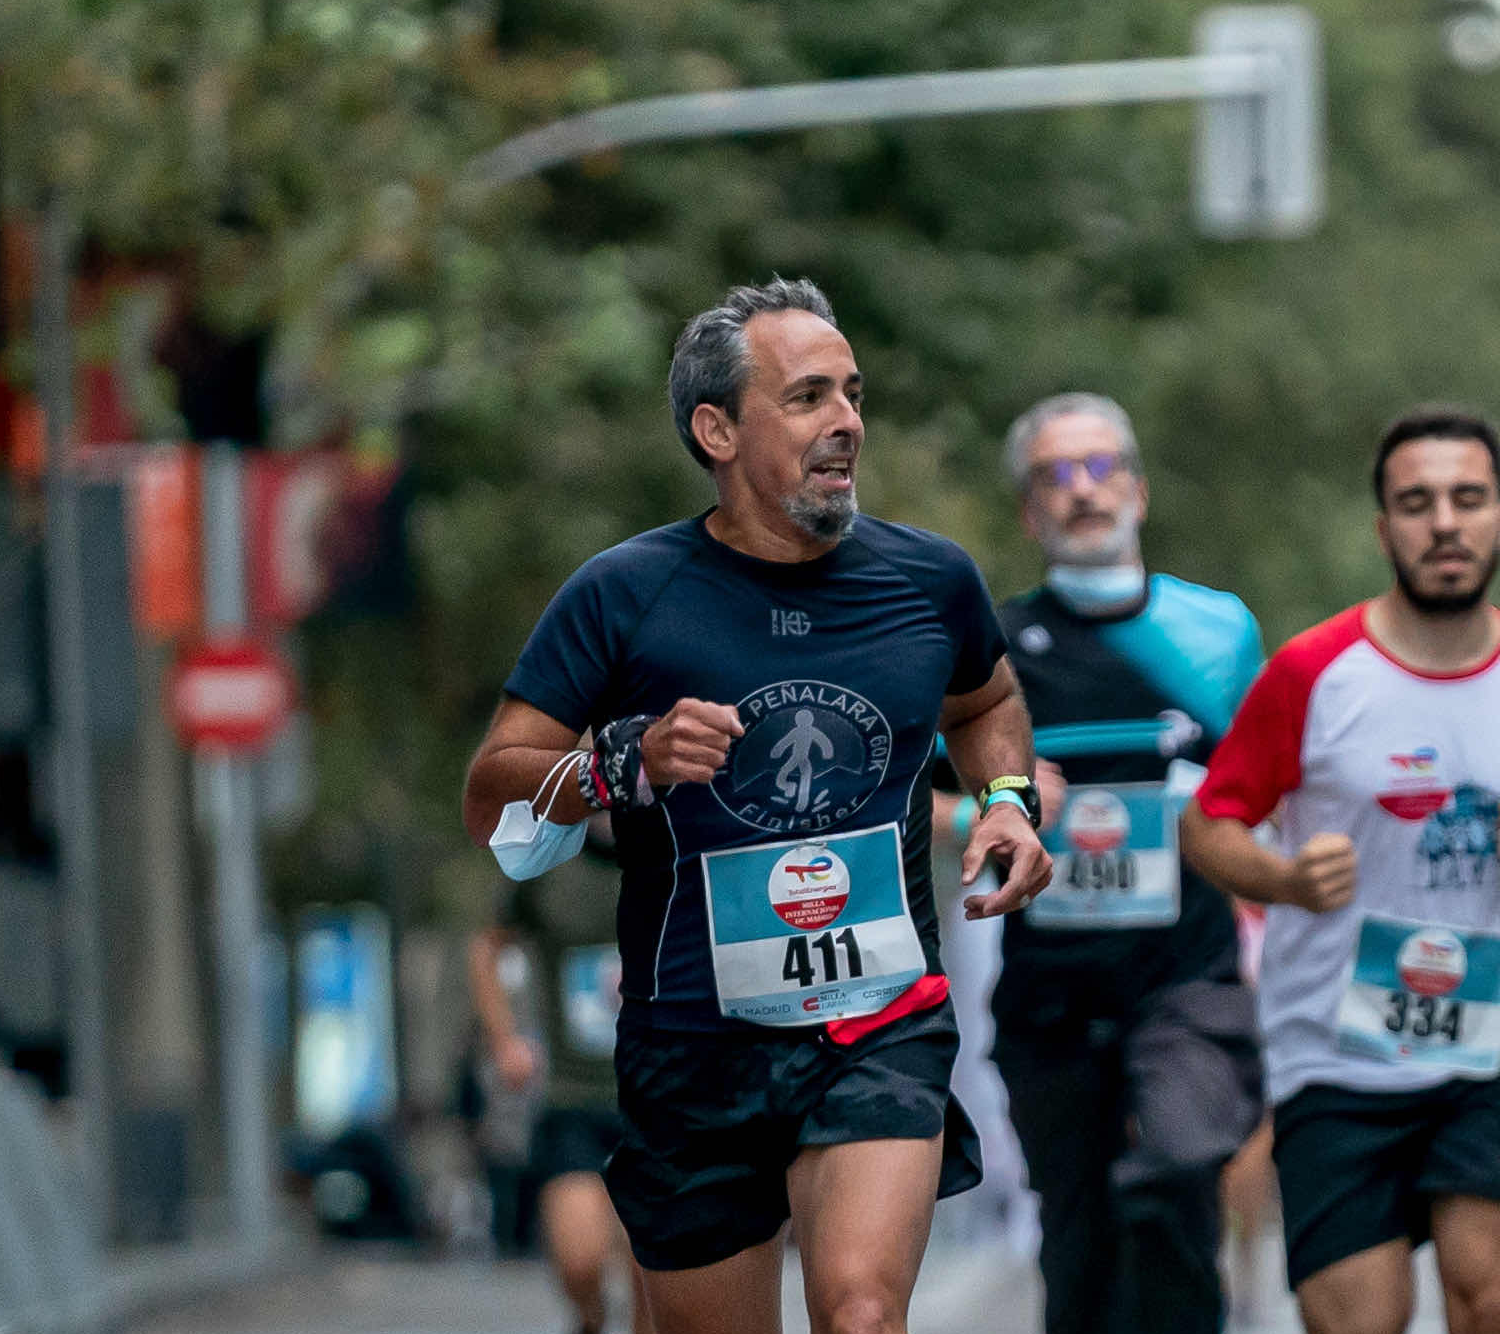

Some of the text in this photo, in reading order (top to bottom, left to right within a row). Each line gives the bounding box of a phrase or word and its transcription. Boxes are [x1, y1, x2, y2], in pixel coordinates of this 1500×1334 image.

[748, 683, 879, 732] PEÑALARA
[738, 796, 860, 830] Finisher
[782, 926, 864, 988] 411
[745, 1003, 792, 1016] MADRID
[1385, 990, 1462, 1042] 334
